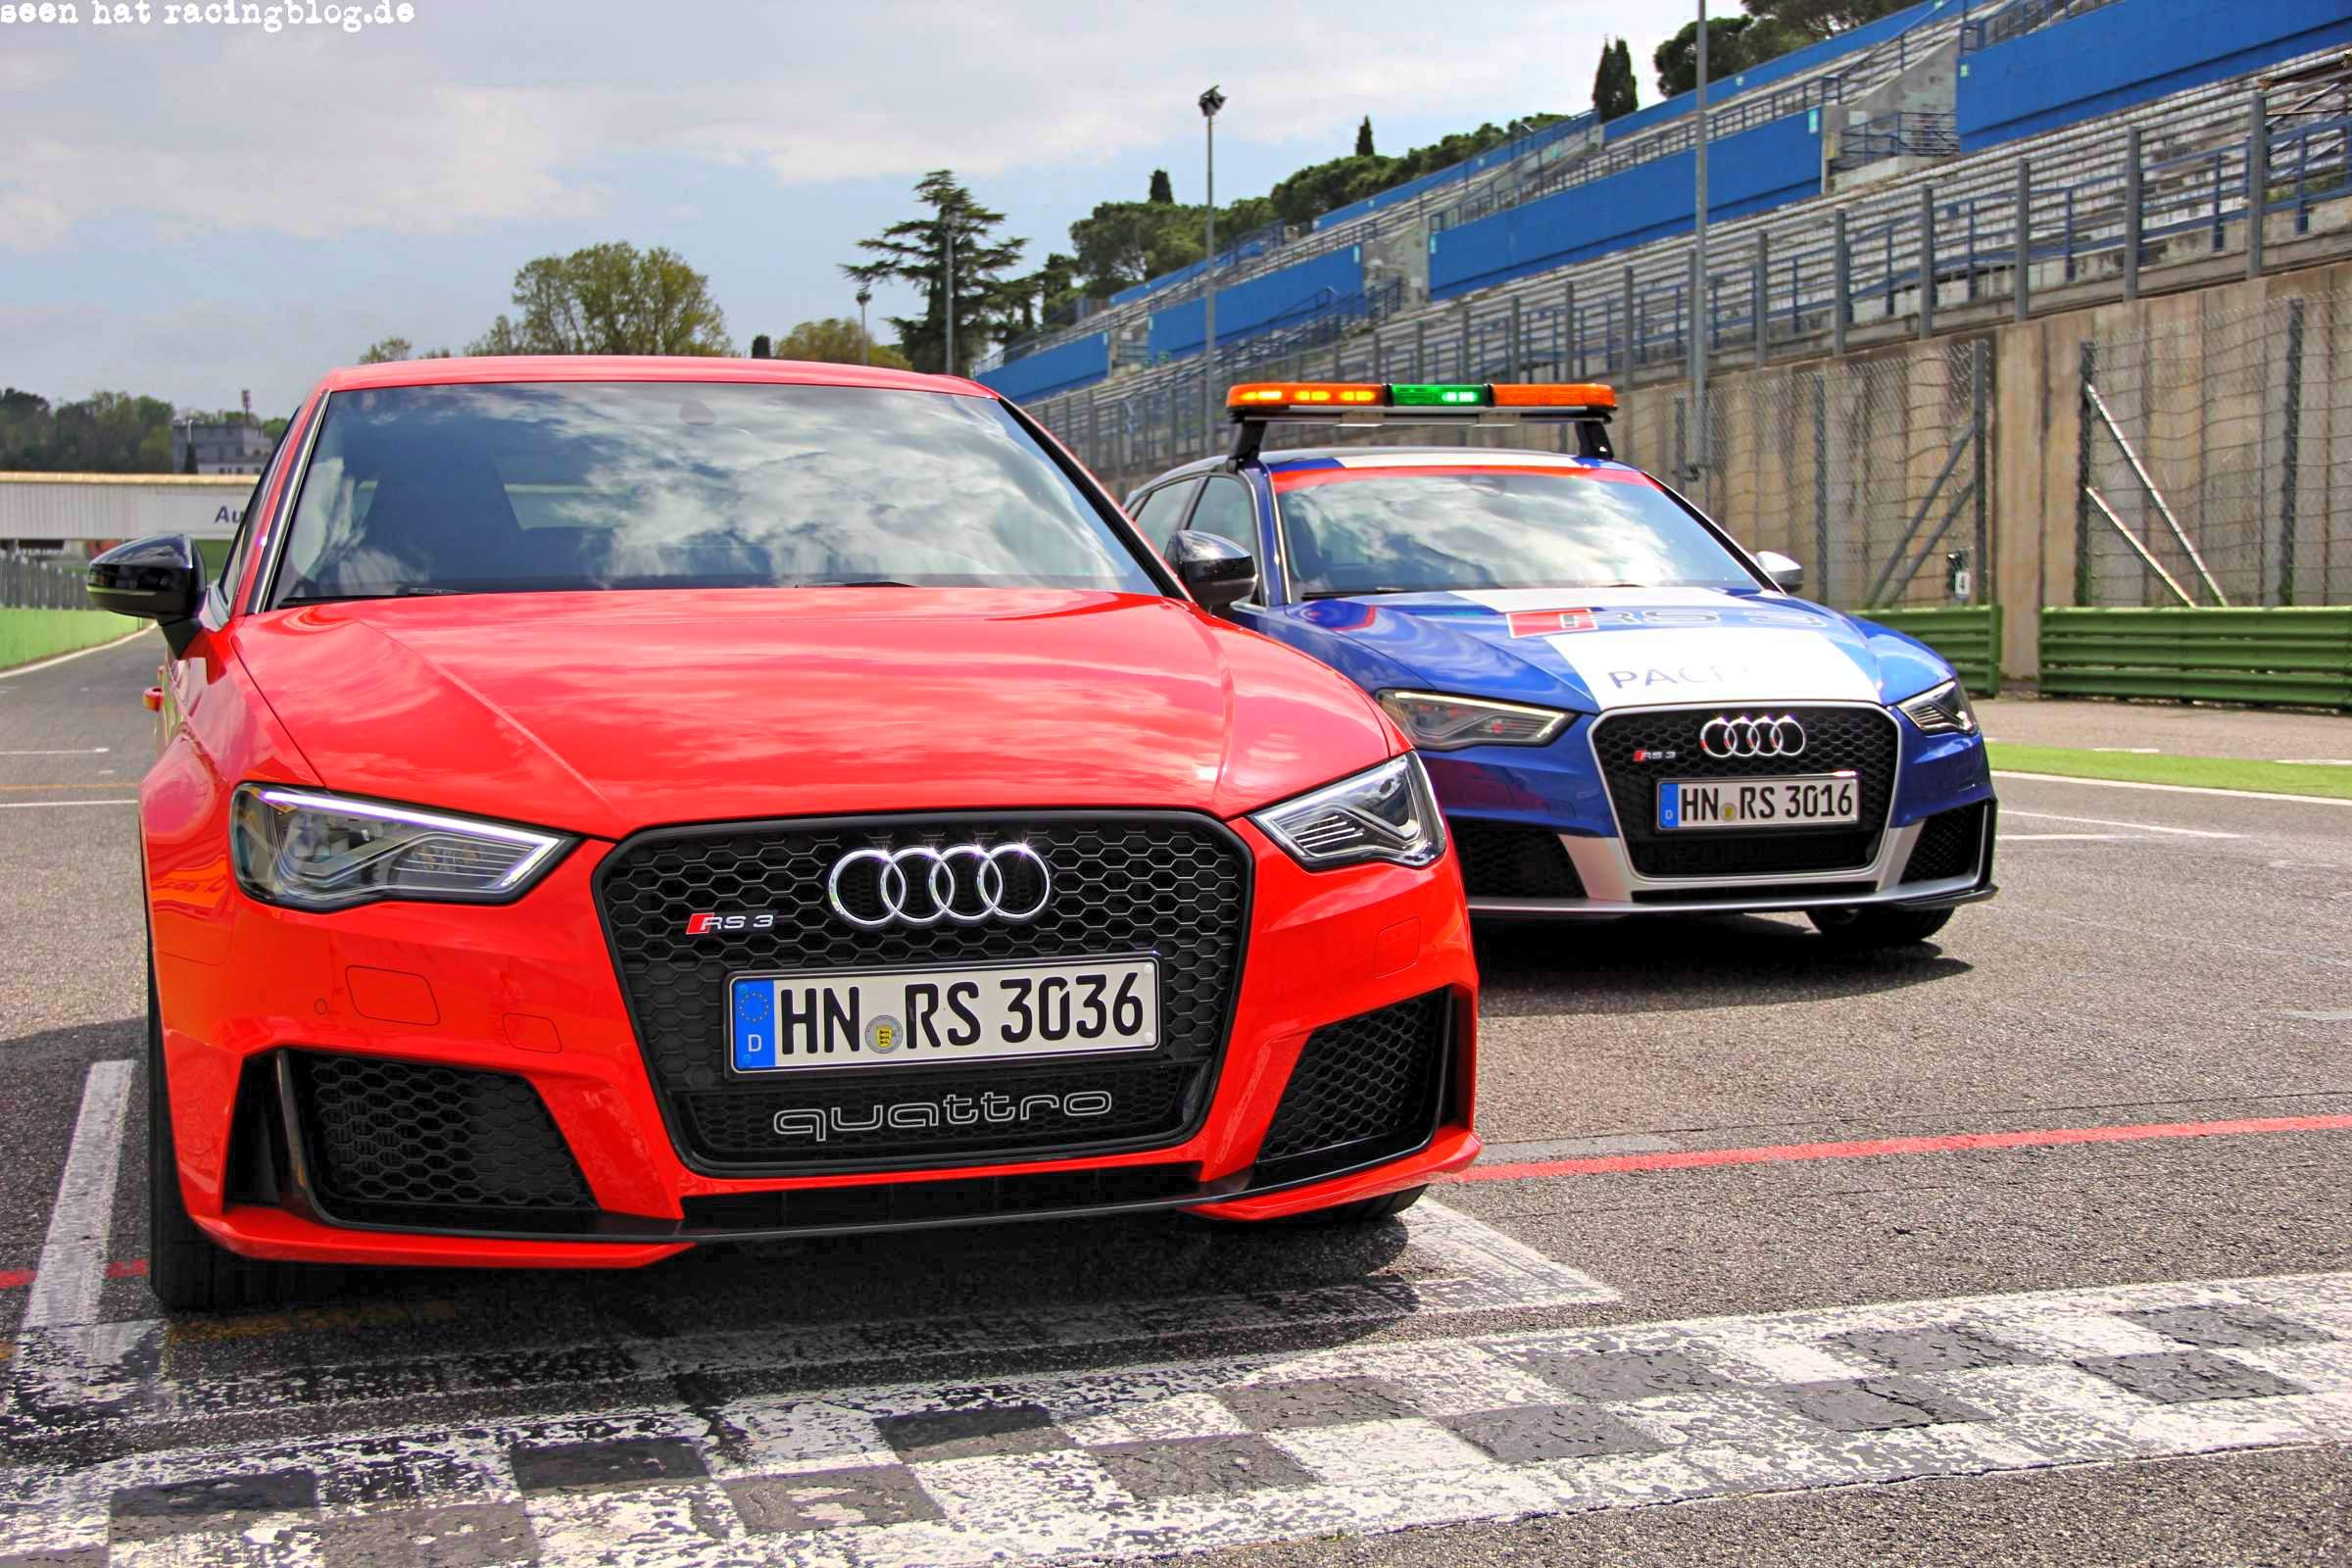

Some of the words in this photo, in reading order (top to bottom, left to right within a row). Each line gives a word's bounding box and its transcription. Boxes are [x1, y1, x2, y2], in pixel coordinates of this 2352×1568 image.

[1608, 665, 1723, 689] PAC
[1664, 751, 1677, 760] 3
[1682, 787, 1719, 821] HN
[1740, 786, 1775, 819] RS
[1786, 783, 1852, 818] 3016
[699, 914, 747, 932] RS
[753, 913, 774, 928] 3
[781, 986, 859, 1055] HN
[905, 981, 981, 1050] RS
[1000, 972, 1144, 1045] 3036
[747, 1034, 762, 1054] D
[773, 1091, 1112, 1143] quattro
